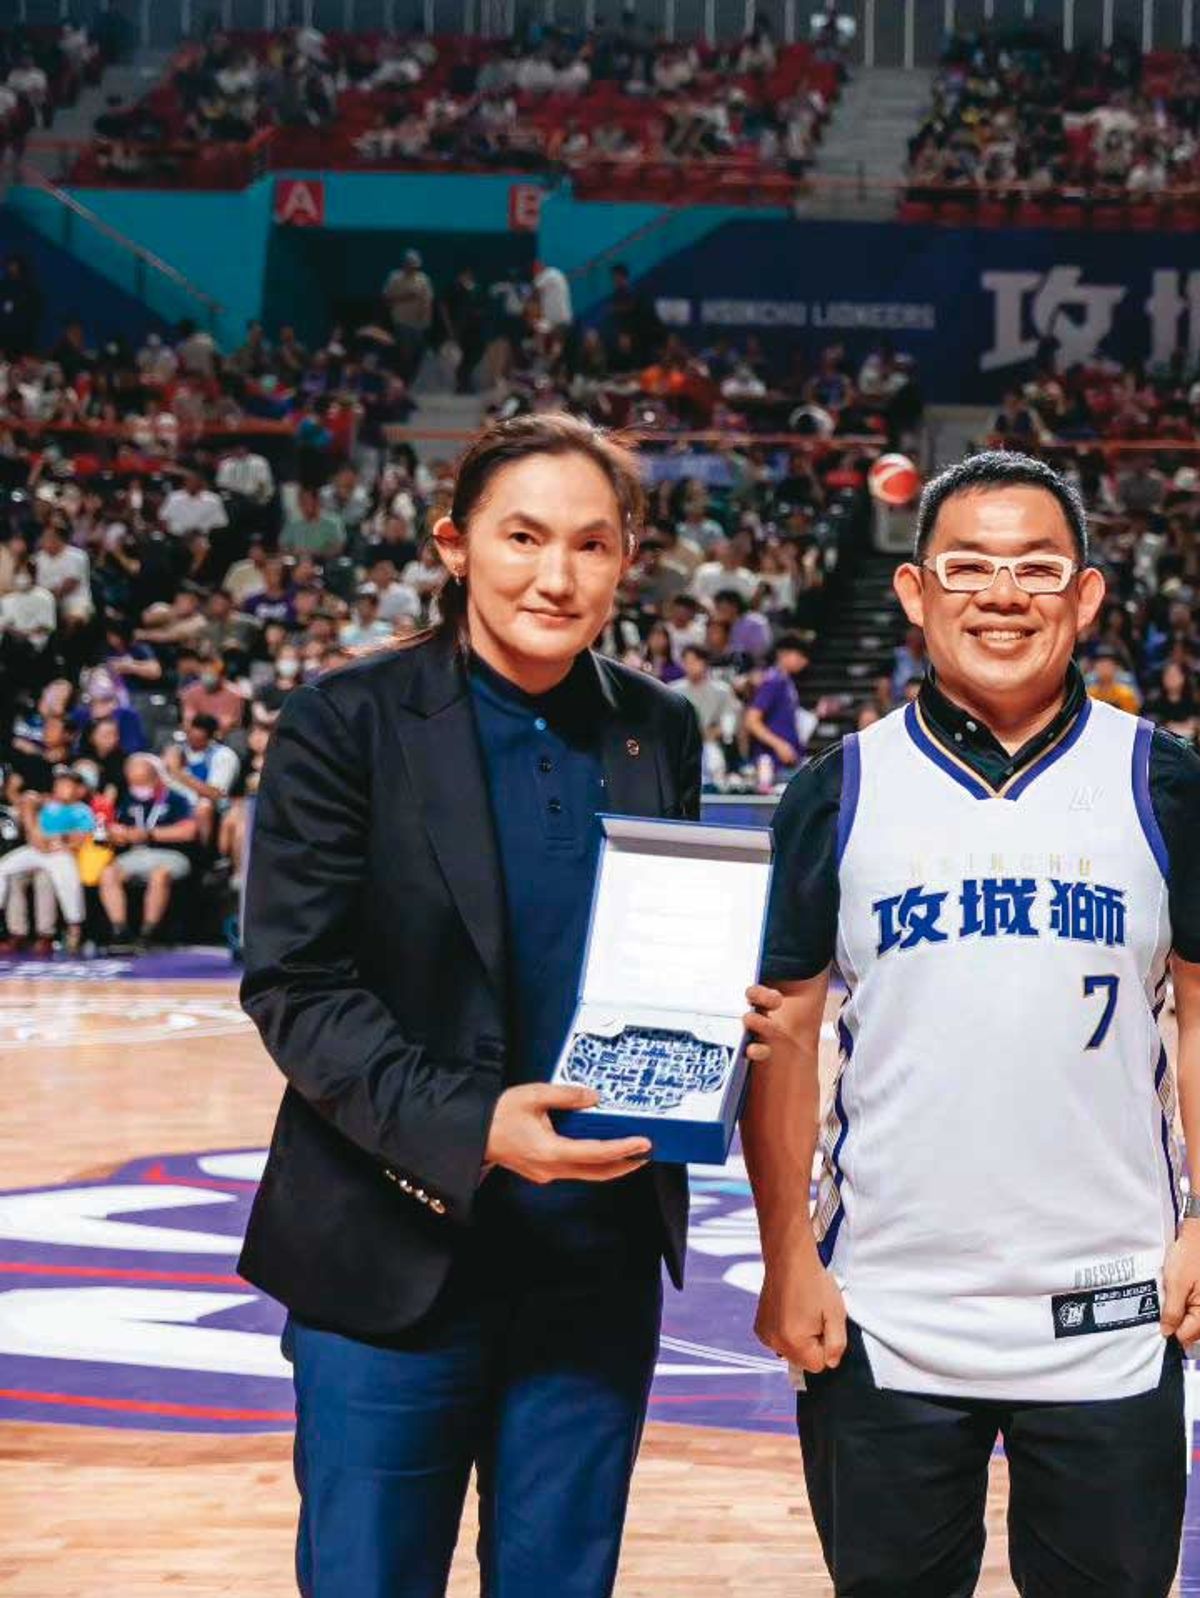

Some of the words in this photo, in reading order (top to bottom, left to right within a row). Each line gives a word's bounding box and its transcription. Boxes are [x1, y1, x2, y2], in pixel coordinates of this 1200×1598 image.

[275, 181, 319, 223] A
[871, 877, 1127, 959] 攻城獅
[1082, 973, 1121, 1051] 7
